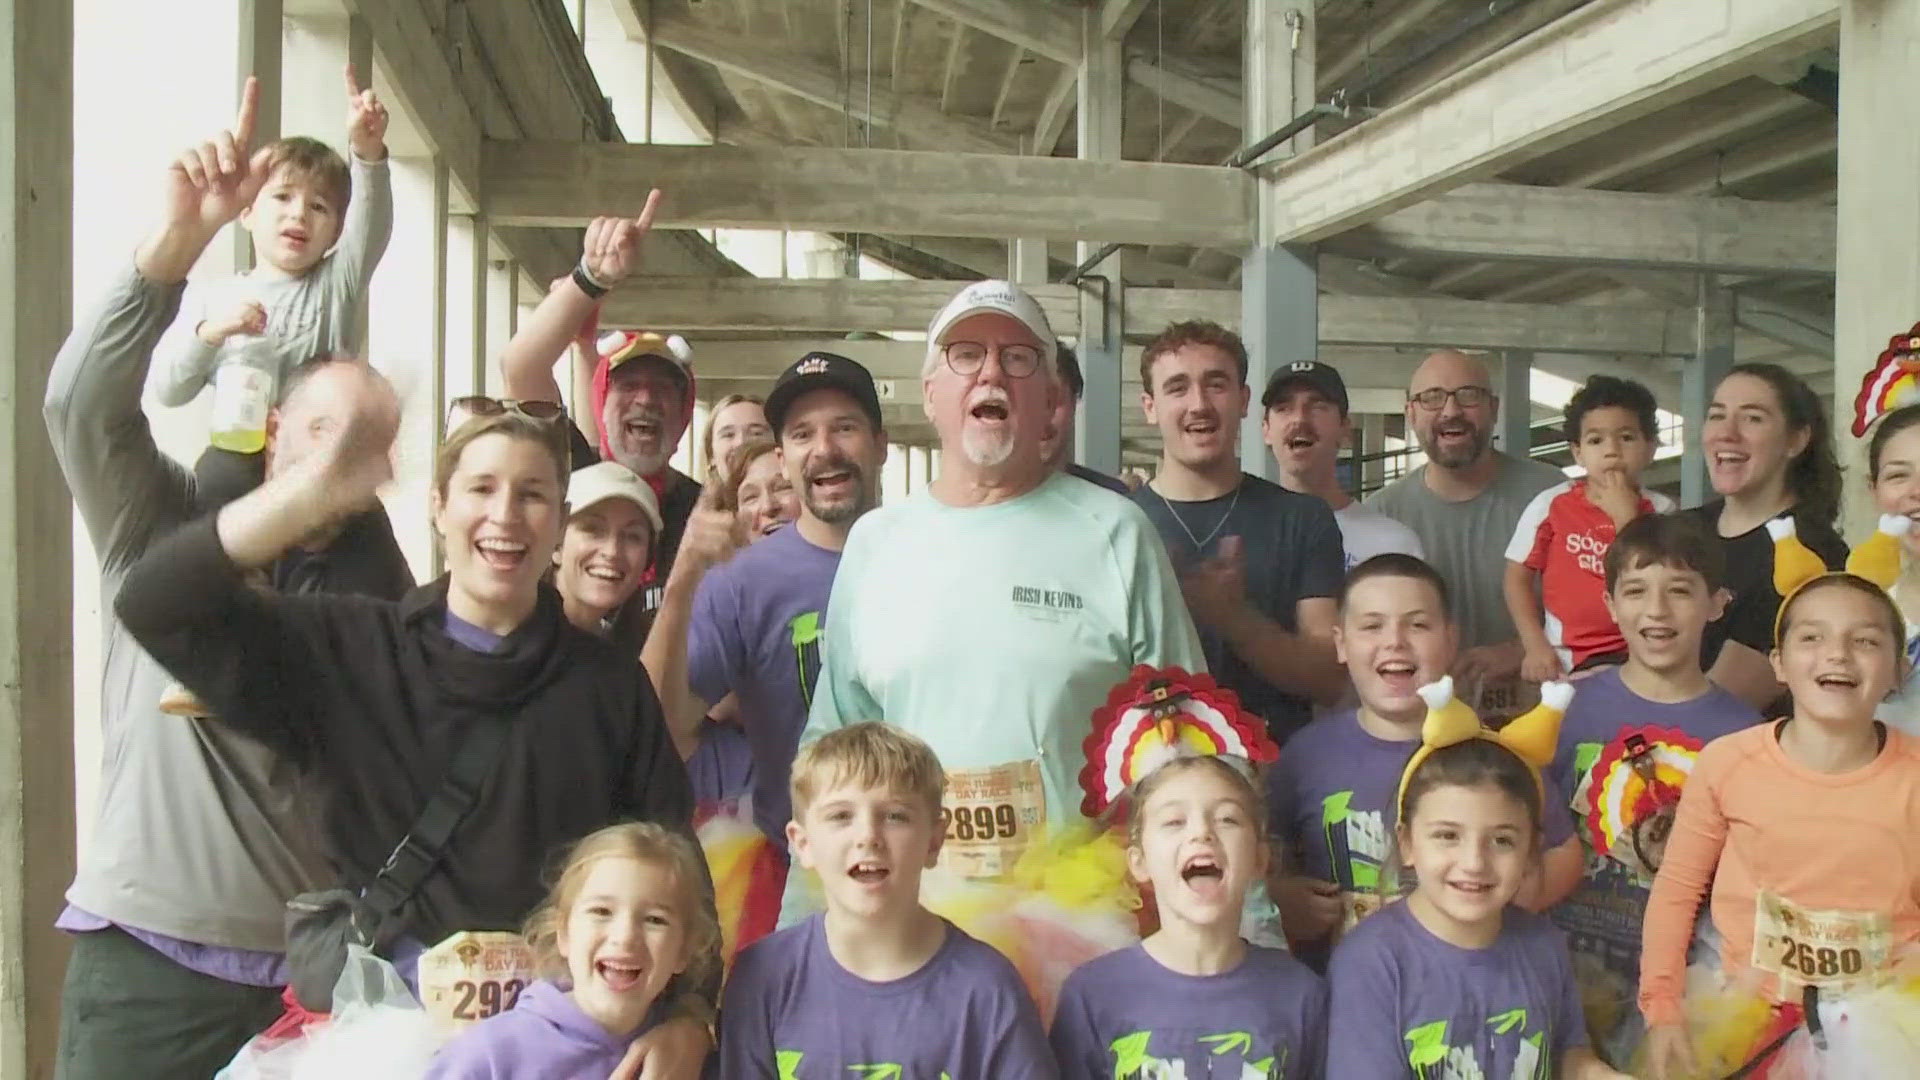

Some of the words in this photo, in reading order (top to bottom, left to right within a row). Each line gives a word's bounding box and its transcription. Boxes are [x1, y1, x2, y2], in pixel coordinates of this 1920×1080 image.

[1012, 585, 1041, 605] IRISH
[940, 803, 1017, 841] 2899
[1780, 934, 1863, 977] 2680
[452, 978, 532, 1020] 292
